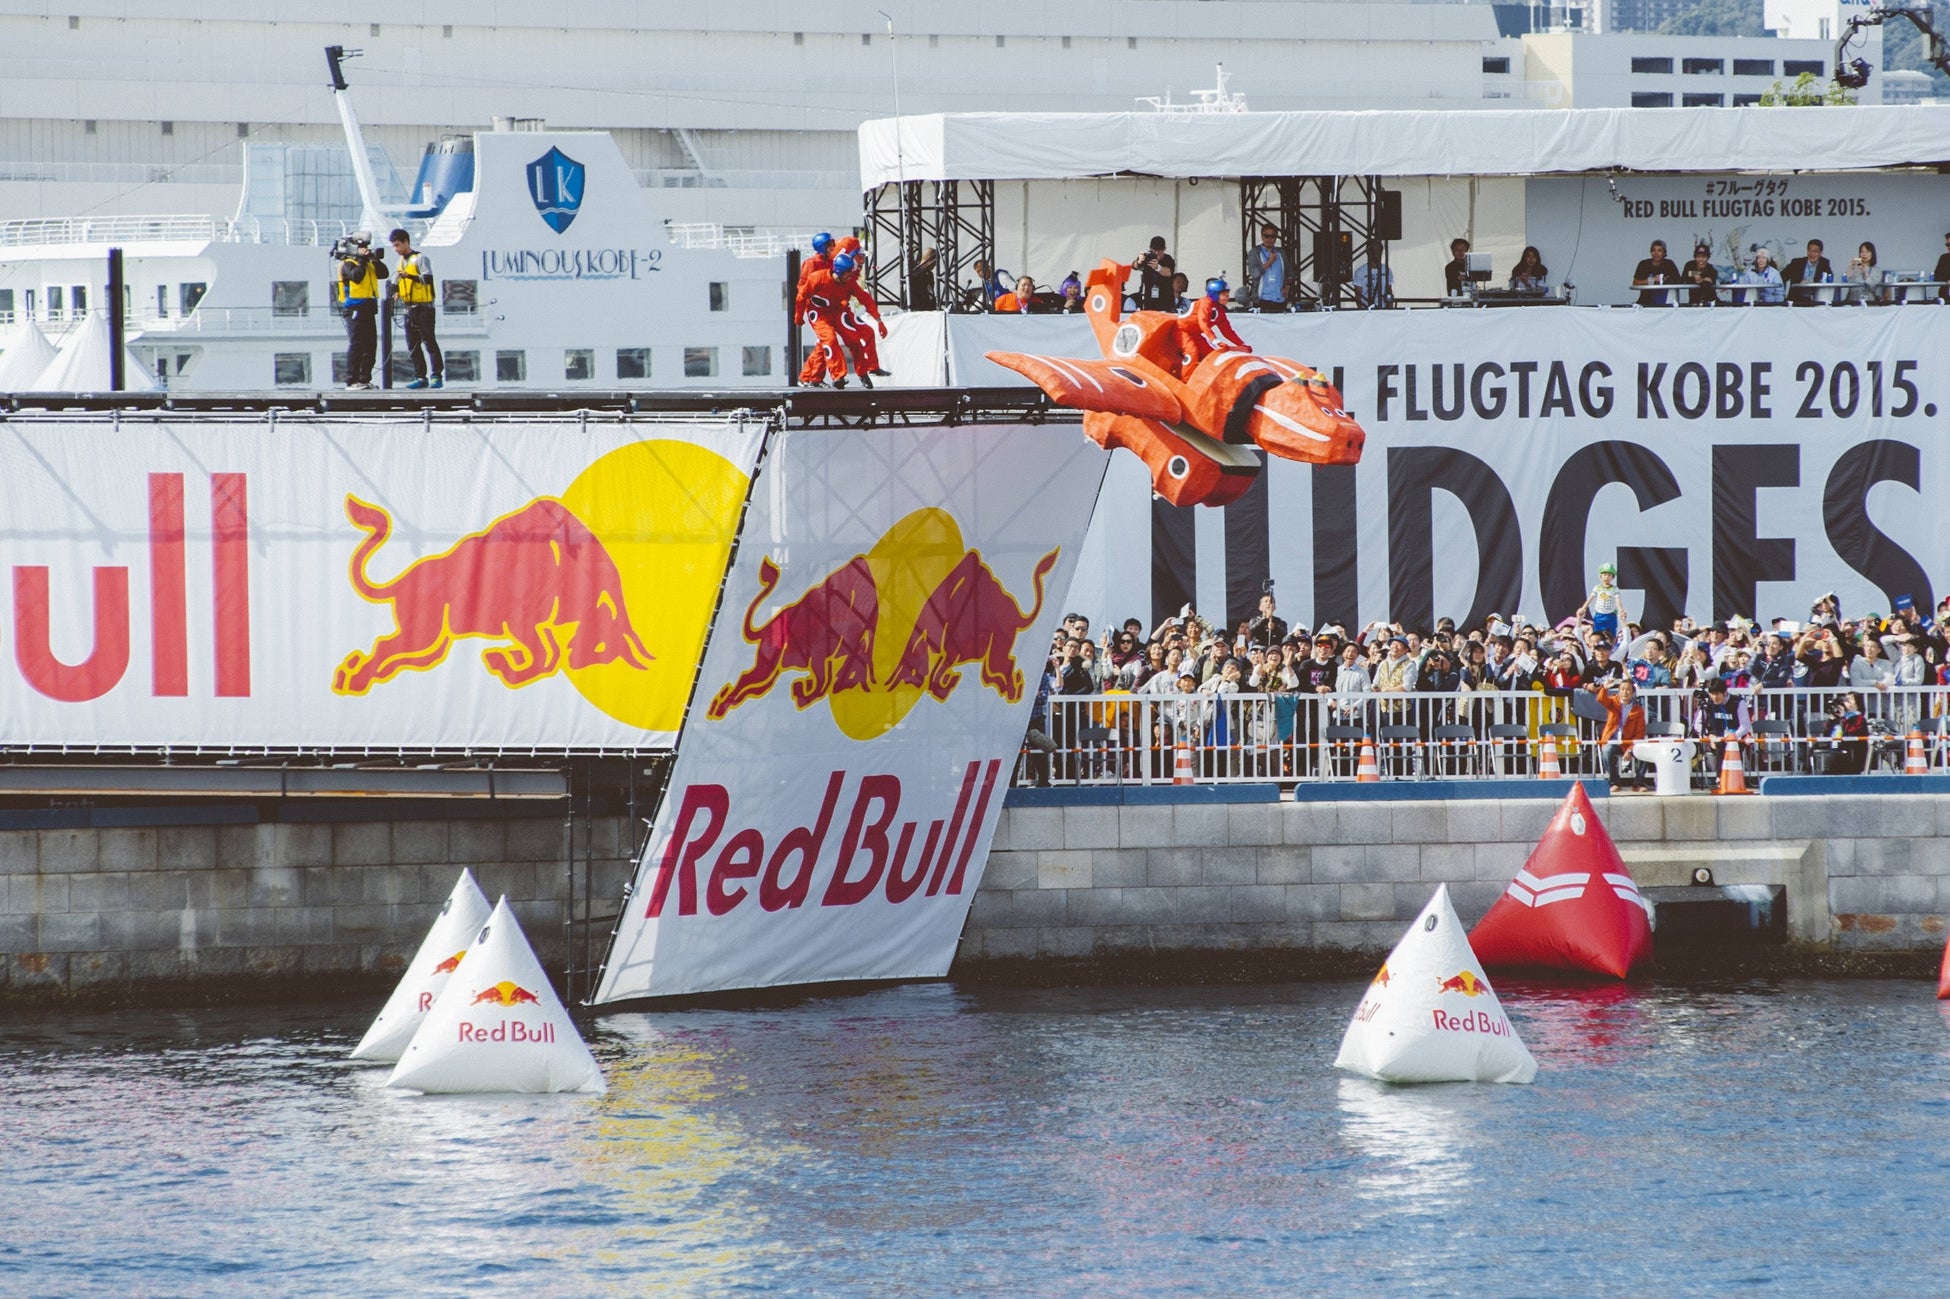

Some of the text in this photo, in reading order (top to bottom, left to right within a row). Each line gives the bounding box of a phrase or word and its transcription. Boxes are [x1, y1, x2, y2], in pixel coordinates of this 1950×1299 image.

[1706, 178, 1790, 197] #フルーグタグ
[1624, 199, 1872, 218] RED BULL FLUGTAG KOBE 2015.
[483, 249, 583, 281] LUMINOUS
[1376, 360, 1615, 422] FLUGTAG
[1636, 361, 1773, 420] KOBE
[1794, 359, 1939, 419] 2015.
[11, 472, 251, 703] ull
[1670, 747, 1684, 763] 2
[644, 758, 1003, 919] Red Bull
[458, 1019, 556, 1044] Red Bull
[1432, 1009, 1512, 1038] Red Bull
